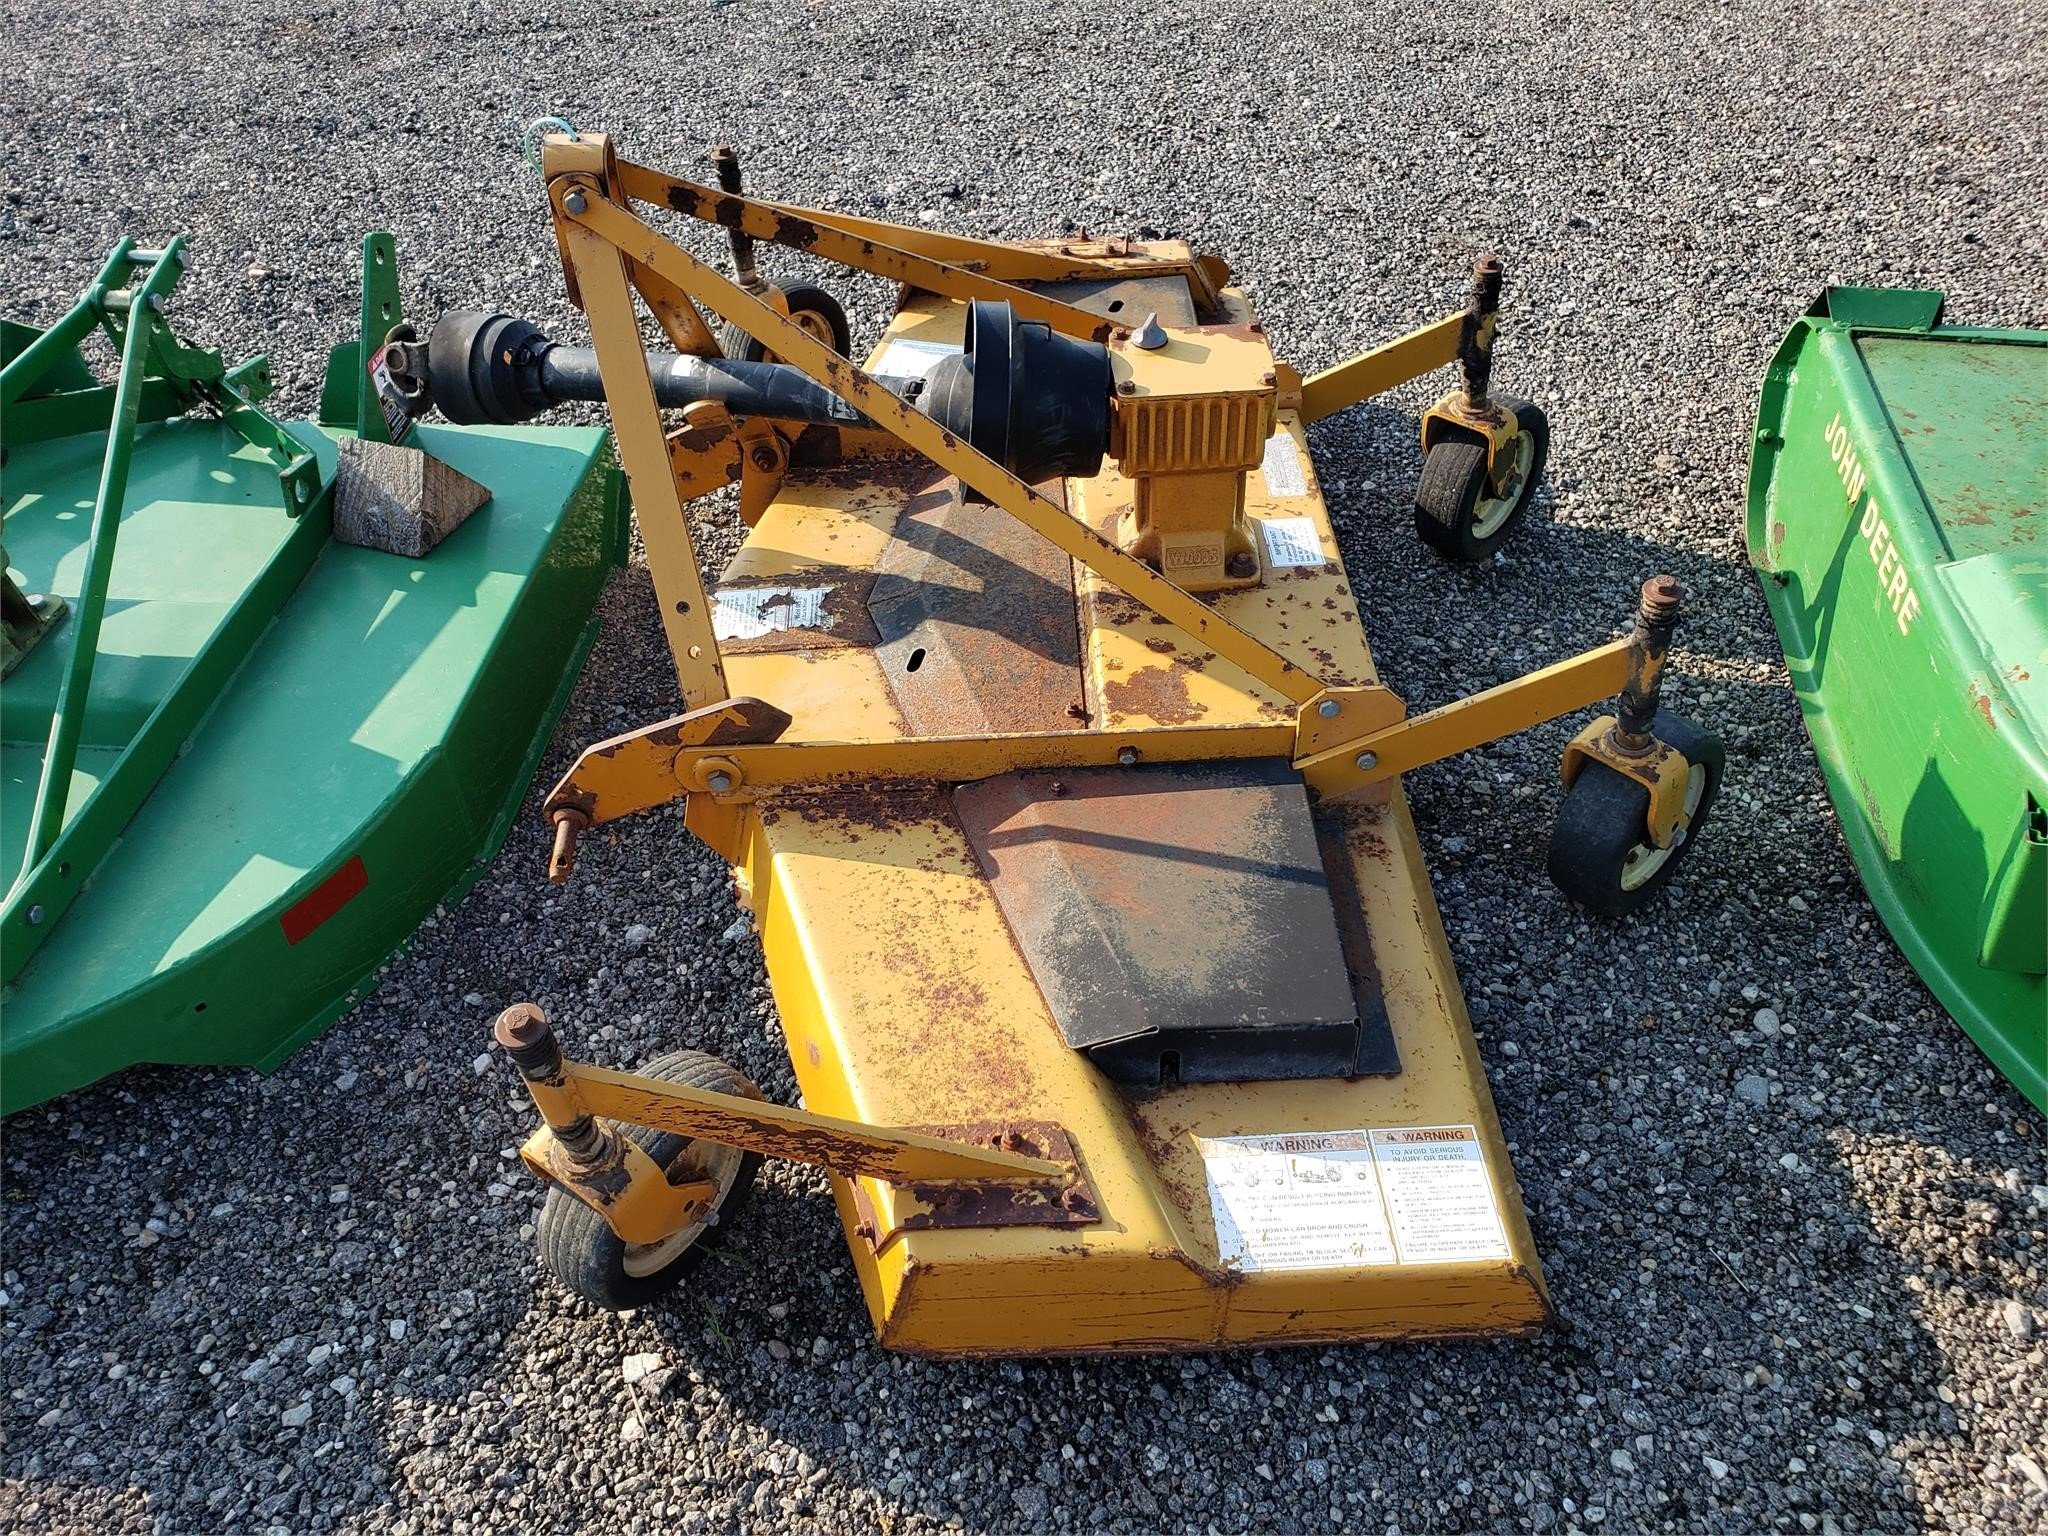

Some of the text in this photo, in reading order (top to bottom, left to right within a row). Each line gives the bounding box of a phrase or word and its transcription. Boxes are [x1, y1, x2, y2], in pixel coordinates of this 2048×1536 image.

[1824, 412, 1921, 637] JOHN DEERE
[1167, 548, 1218, 566] WOODS
[1402, 1130, 1465, 1142] WARNING
[1260, 1138, 1333, 1152] WARNING
[1403, 1148, 1427, 1156] AVOID
[1429, 1146, 1464, 1154] SERIOUS
